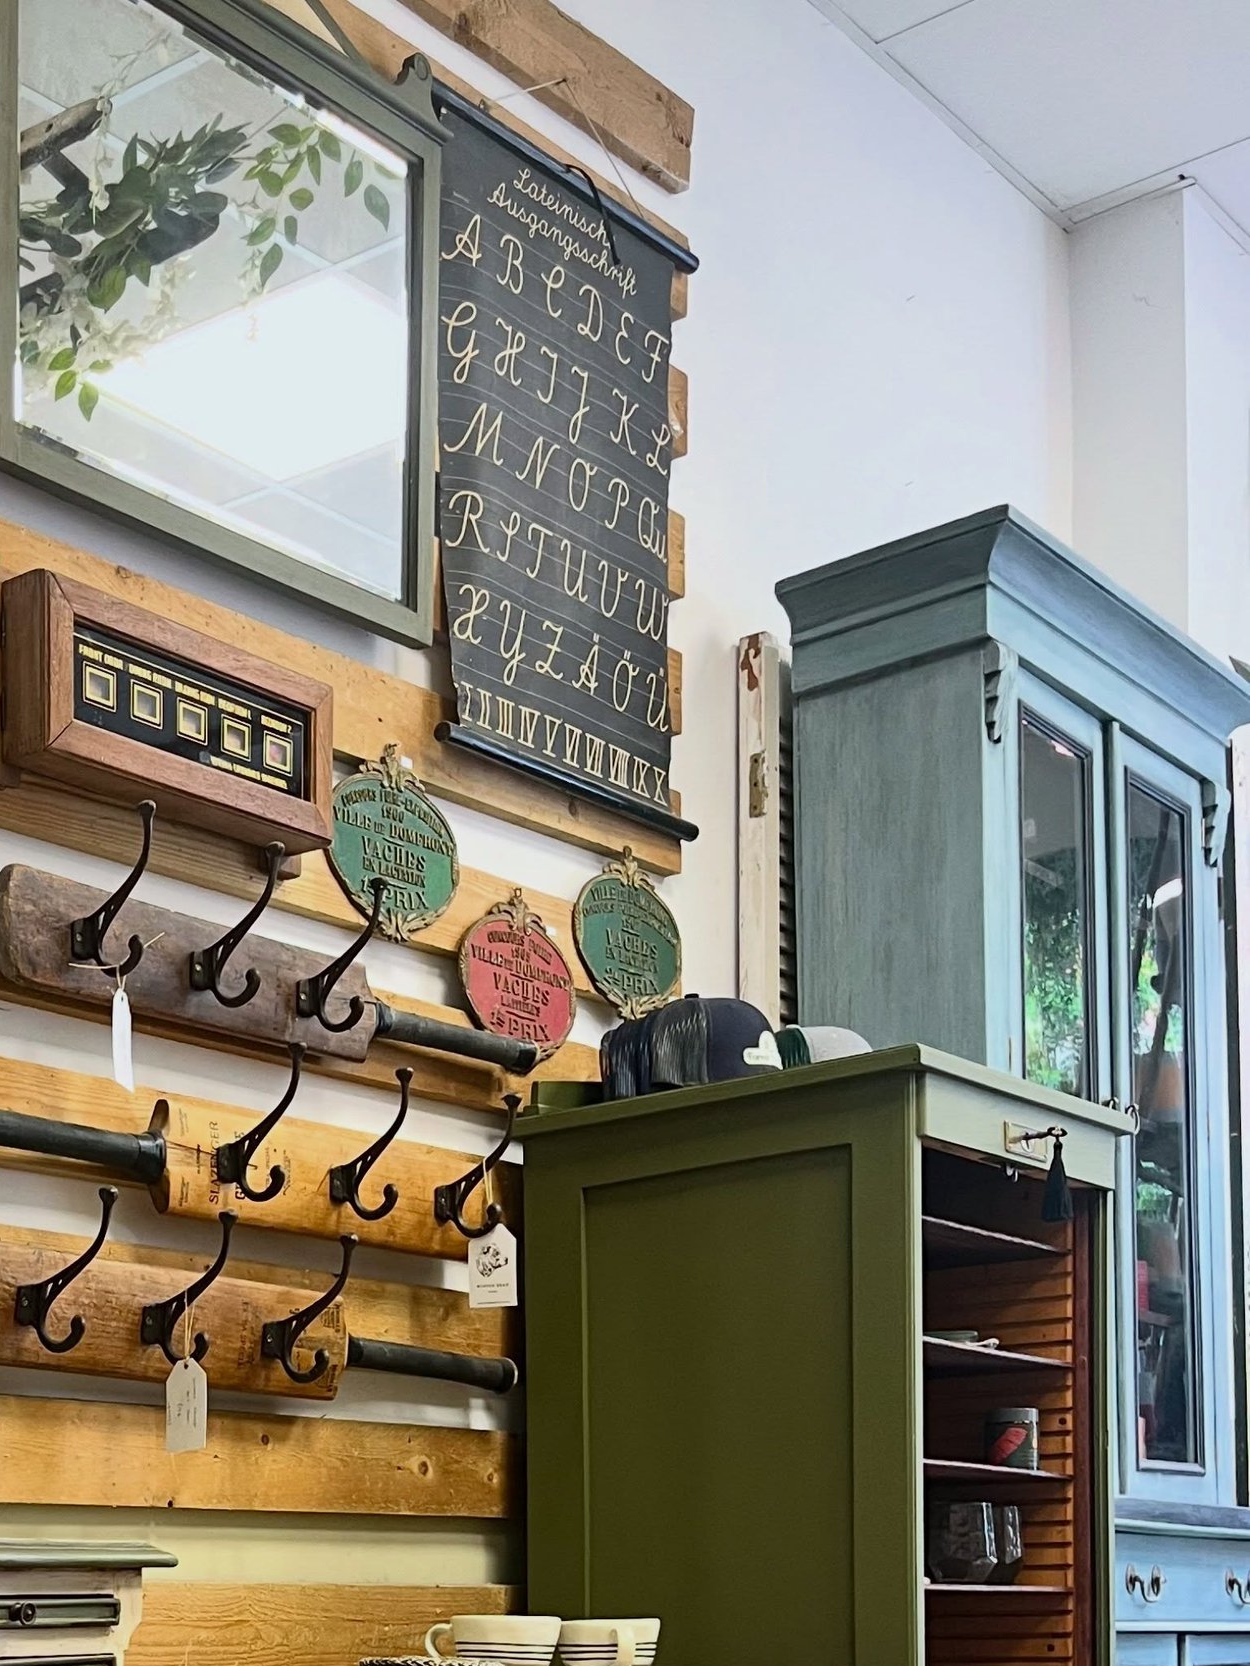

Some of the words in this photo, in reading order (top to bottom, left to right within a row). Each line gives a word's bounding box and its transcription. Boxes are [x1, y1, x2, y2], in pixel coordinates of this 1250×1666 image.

[487, 182, 637, 298] Ausgangsschrift
[513, 168, 616, 249] Lateinisch
[441, 215, 482, 267] A
[496, 234, 524, 294] B
[542, 266, 564, 318] C
[578, 284, 603, 342] D
[616, 312, 634, 364] E
[642, 330, 669, 382] F
[441, 302, 479, 383] G
[494, 317, 526, 386] H
[610, 388, 640, 456] K
[444, 403, 503, 465] M
[516, 436, 560, 489] N
[569, 458, 595, 511] O
[605, 478, 630, 529] P
[446, 490, 490, 553] R
[497, 512, 520, 560] S
[527, 523, 553, 578] T
[560, 539, 588, 603] U
[598, 560, 628, 617] V
[635, 579, 669, 641] W
[453, 584, 490, 645] X
[500, 600, 526, 686] Y
[536, 621, 563, 681] Z
[572, 632, 599, 695] Ä
[613, 649, 638, 712] Ö
[476, 688, 492, 730] II
[496, 696, 515, 739] III
[518, 705, 540, 748] IV
[543, 714, 563, 758] V
[563, 723, 582, 768] VI
[584, 733, 606, 778] VII
[608, 744, 630, 789] VIII
[632, 756, 650, 798] IX
[653, 766, 668, 806] X
[333, 806, 371, 831] VILLE
[362, 836, 426, 873] VACHES
[382, 888, 429, 911] PRIX
[471, 944, 503, 968] VILLE
[606, 928, 658, 960] VACHES
[493, 972, 550, 1006] VACHES
[508, 1017, 550, 1042] PRIX
